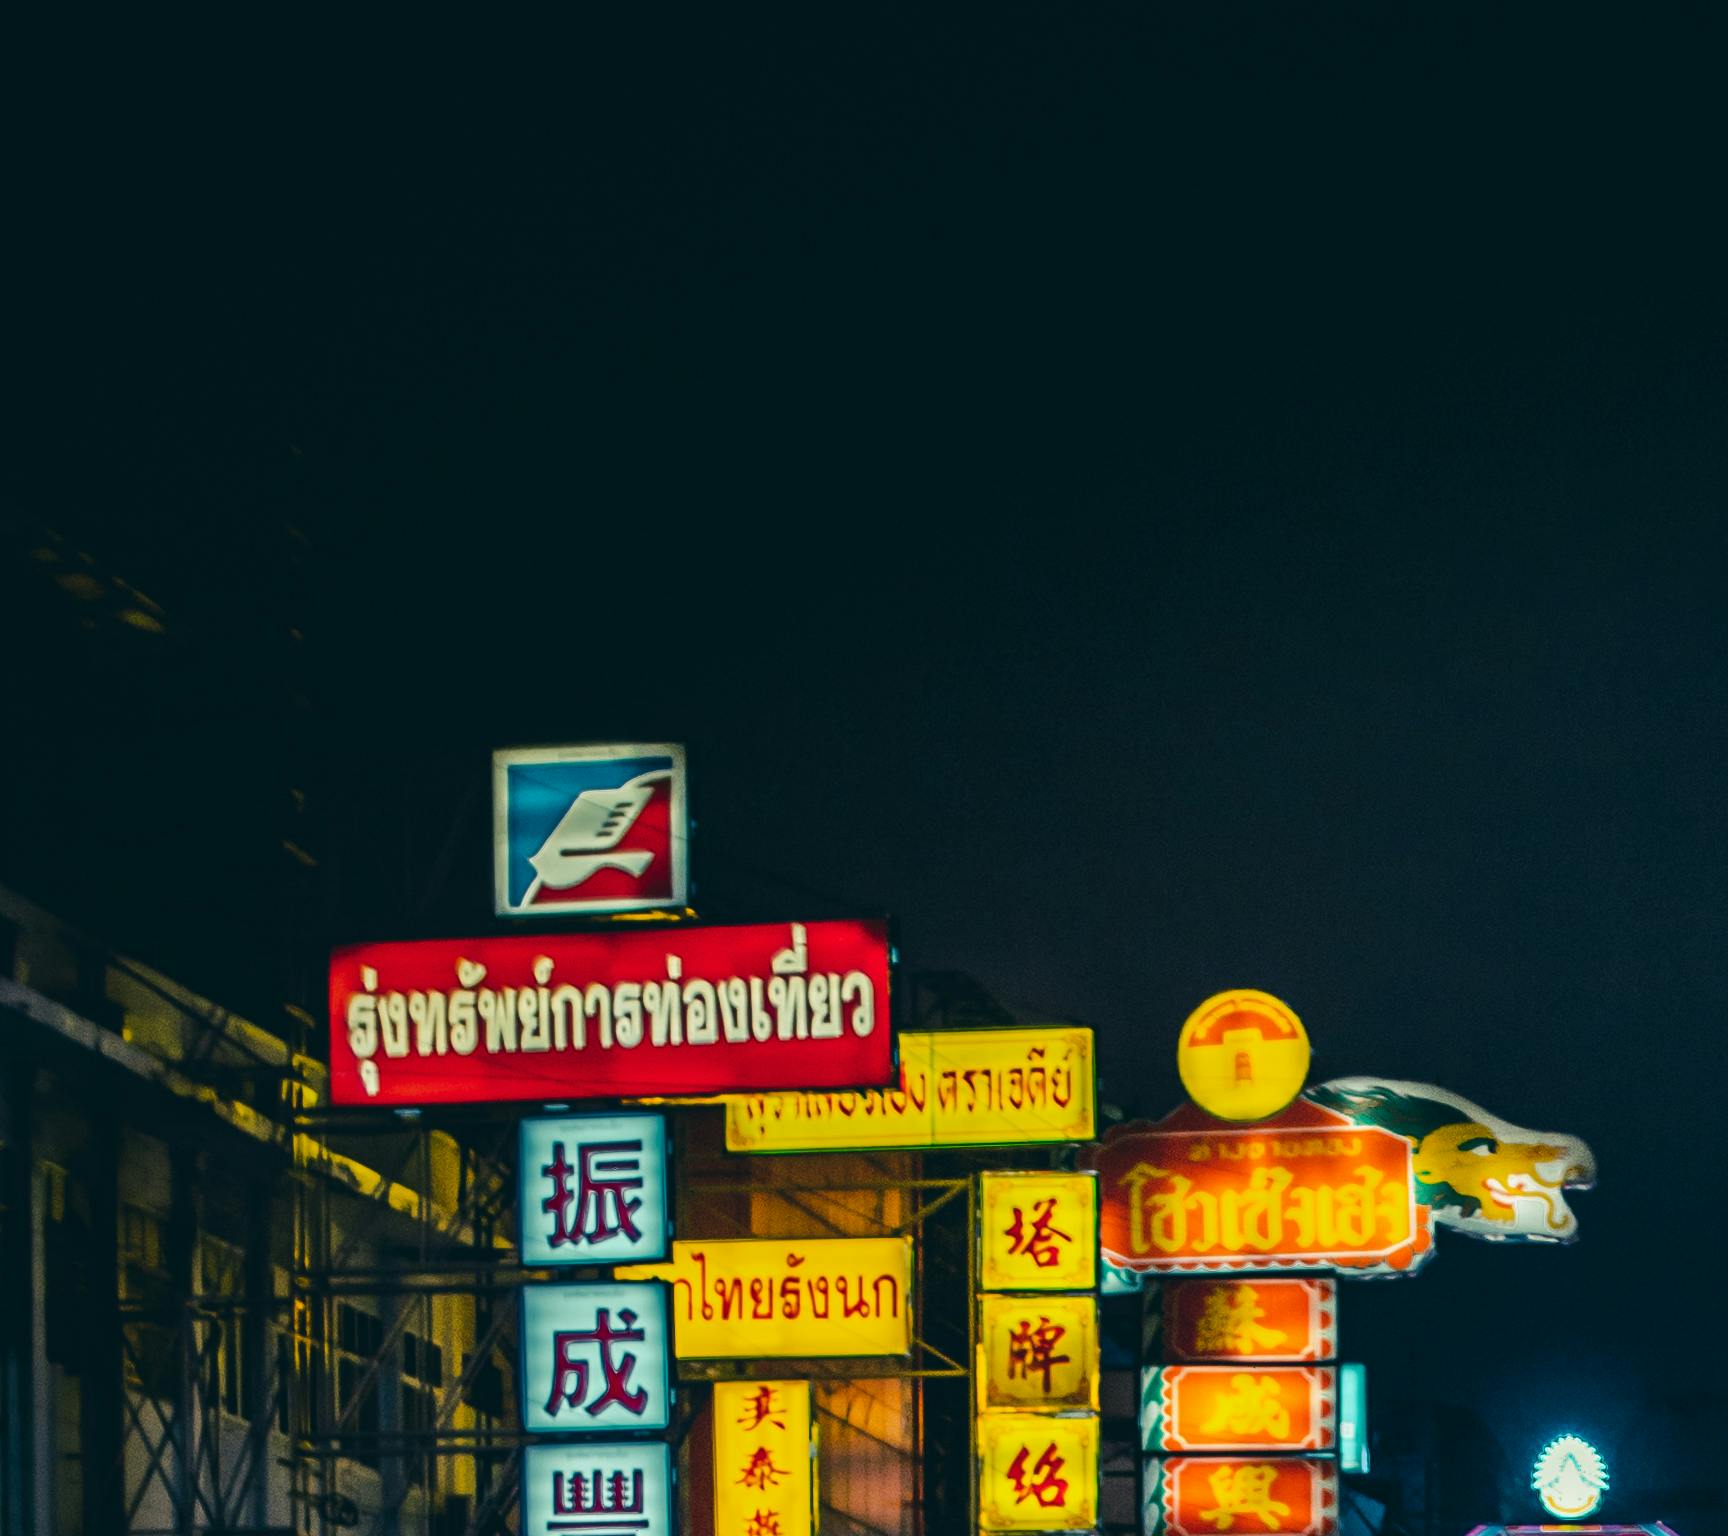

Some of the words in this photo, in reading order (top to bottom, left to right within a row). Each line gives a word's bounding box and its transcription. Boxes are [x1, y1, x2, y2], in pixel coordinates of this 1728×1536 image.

[347, 922, 875, 1095] รุ่งทรัพย์การท่องเที่ยว
